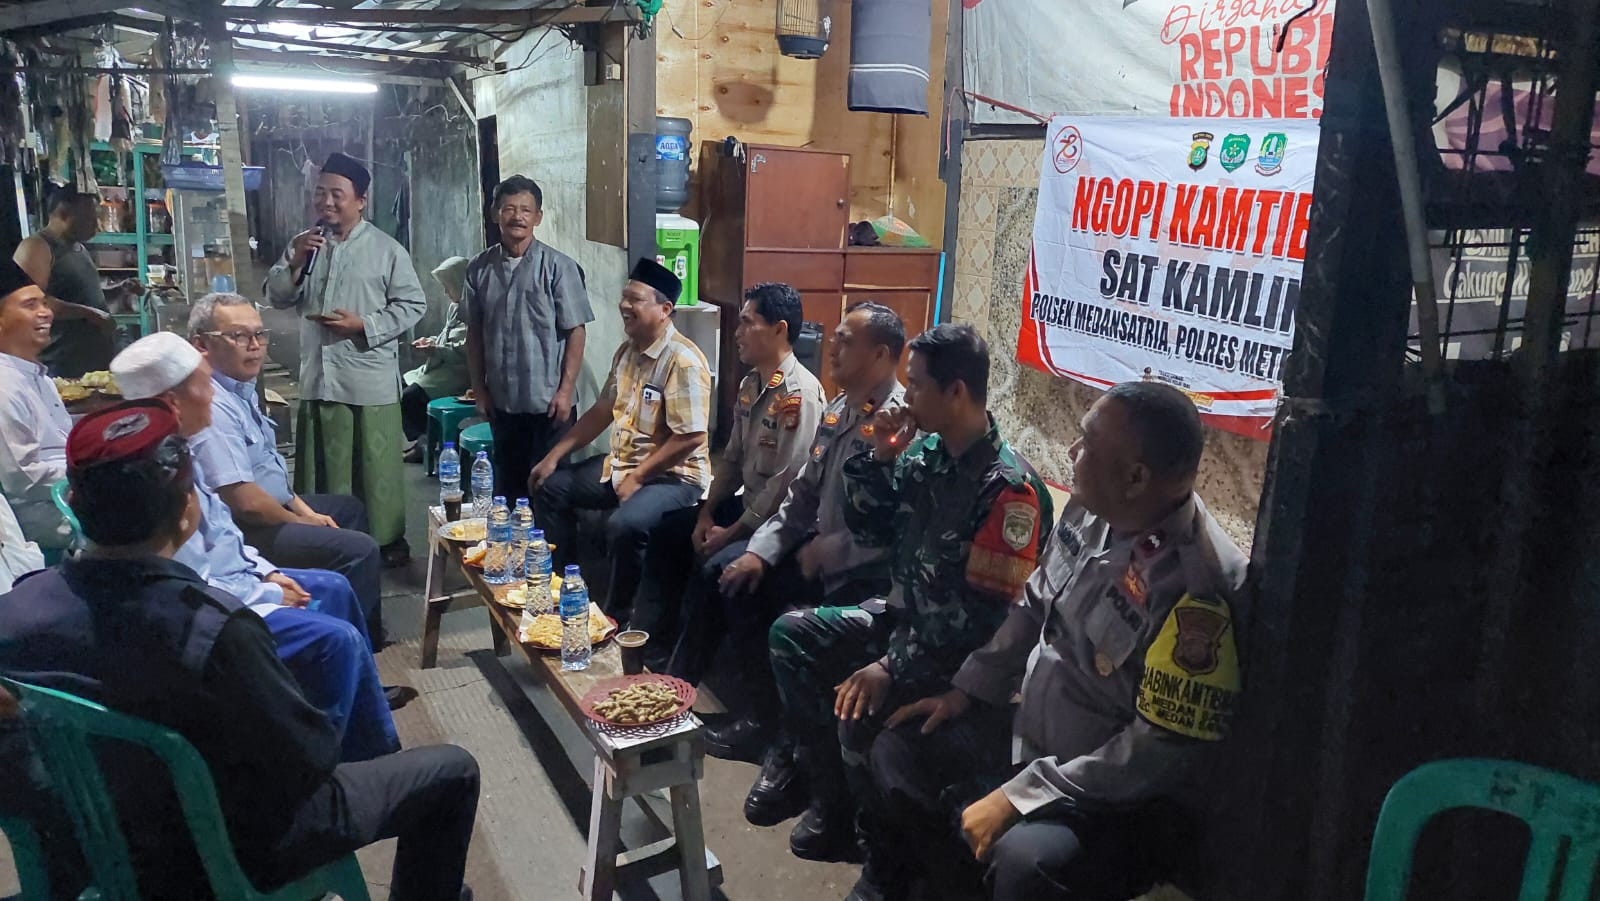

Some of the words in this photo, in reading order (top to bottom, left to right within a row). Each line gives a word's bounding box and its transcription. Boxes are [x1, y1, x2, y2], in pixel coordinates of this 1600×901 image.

[1072, 176, 1167, 240] NGOPI
[1100, 249, 1159, 304] SAT
[1030, 293, 1074, 327] POLSEK
[1075, 305, 1172, 359] MEDANSATRIA,
[1175, 326, 1239, 371] POLRES
